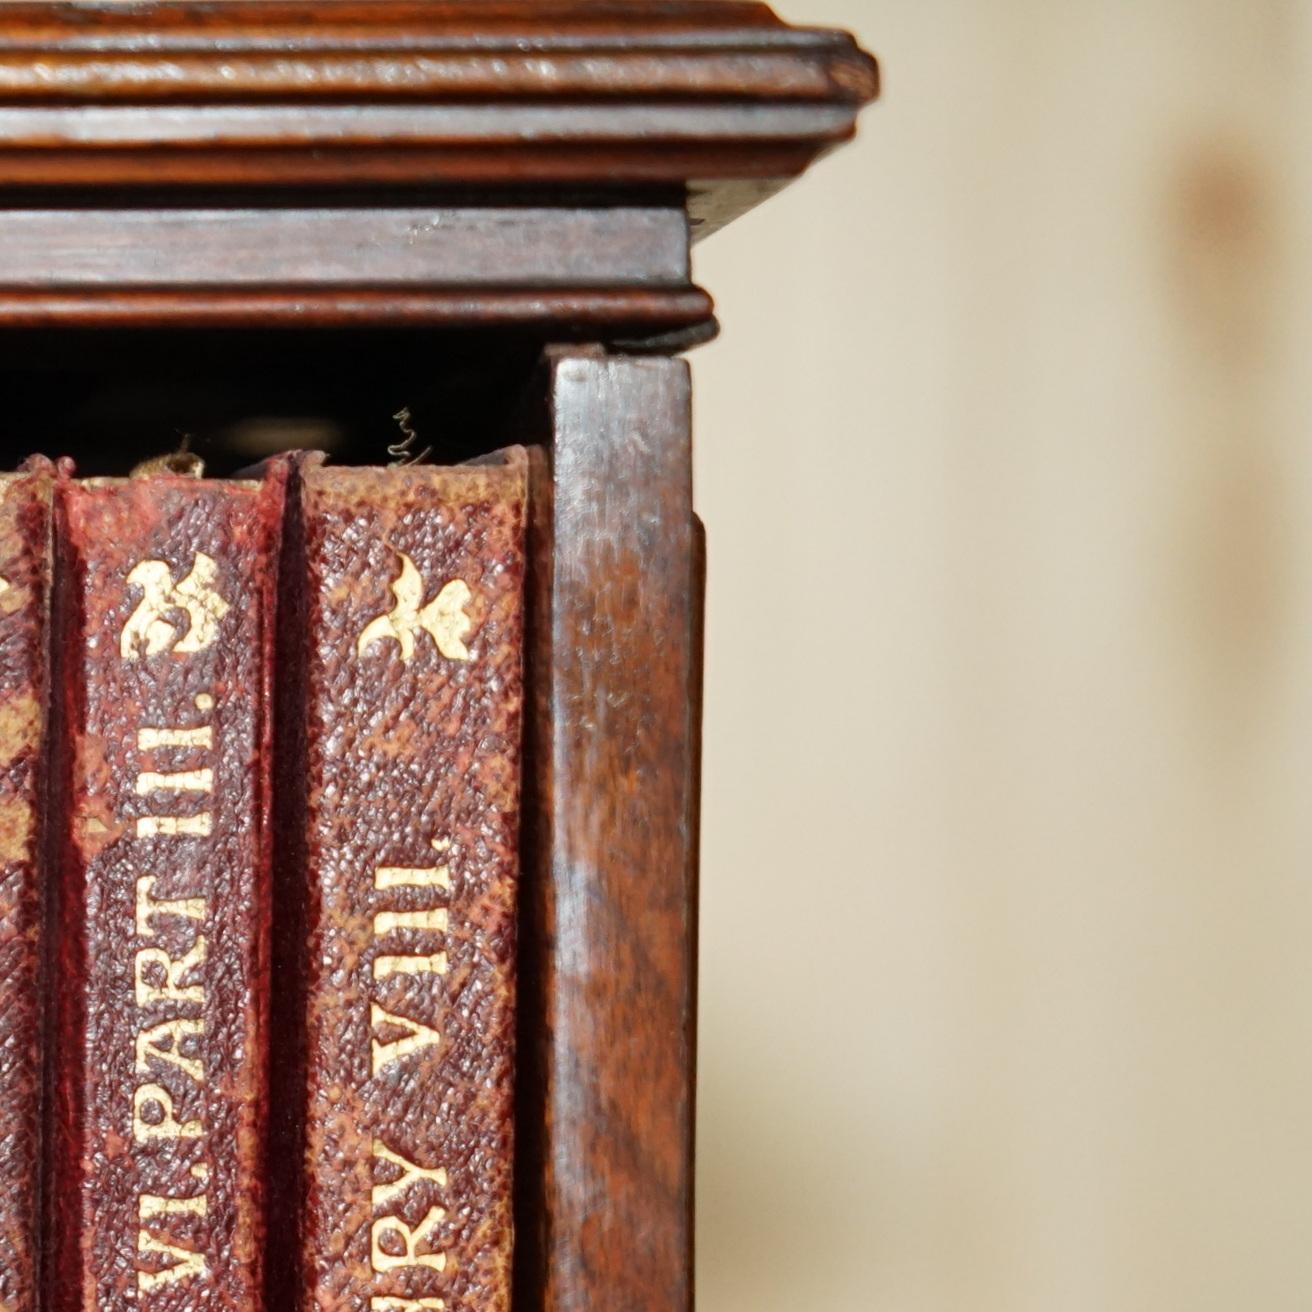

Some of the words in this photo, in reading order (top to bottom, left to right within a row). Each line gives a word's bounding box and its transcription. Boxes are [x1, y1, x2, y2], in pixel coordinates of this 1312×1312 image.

[135, 692, 215, 839] III.
[133, 874, 207, 1143] PART
[137, 1163, 209, 1299] VI.
